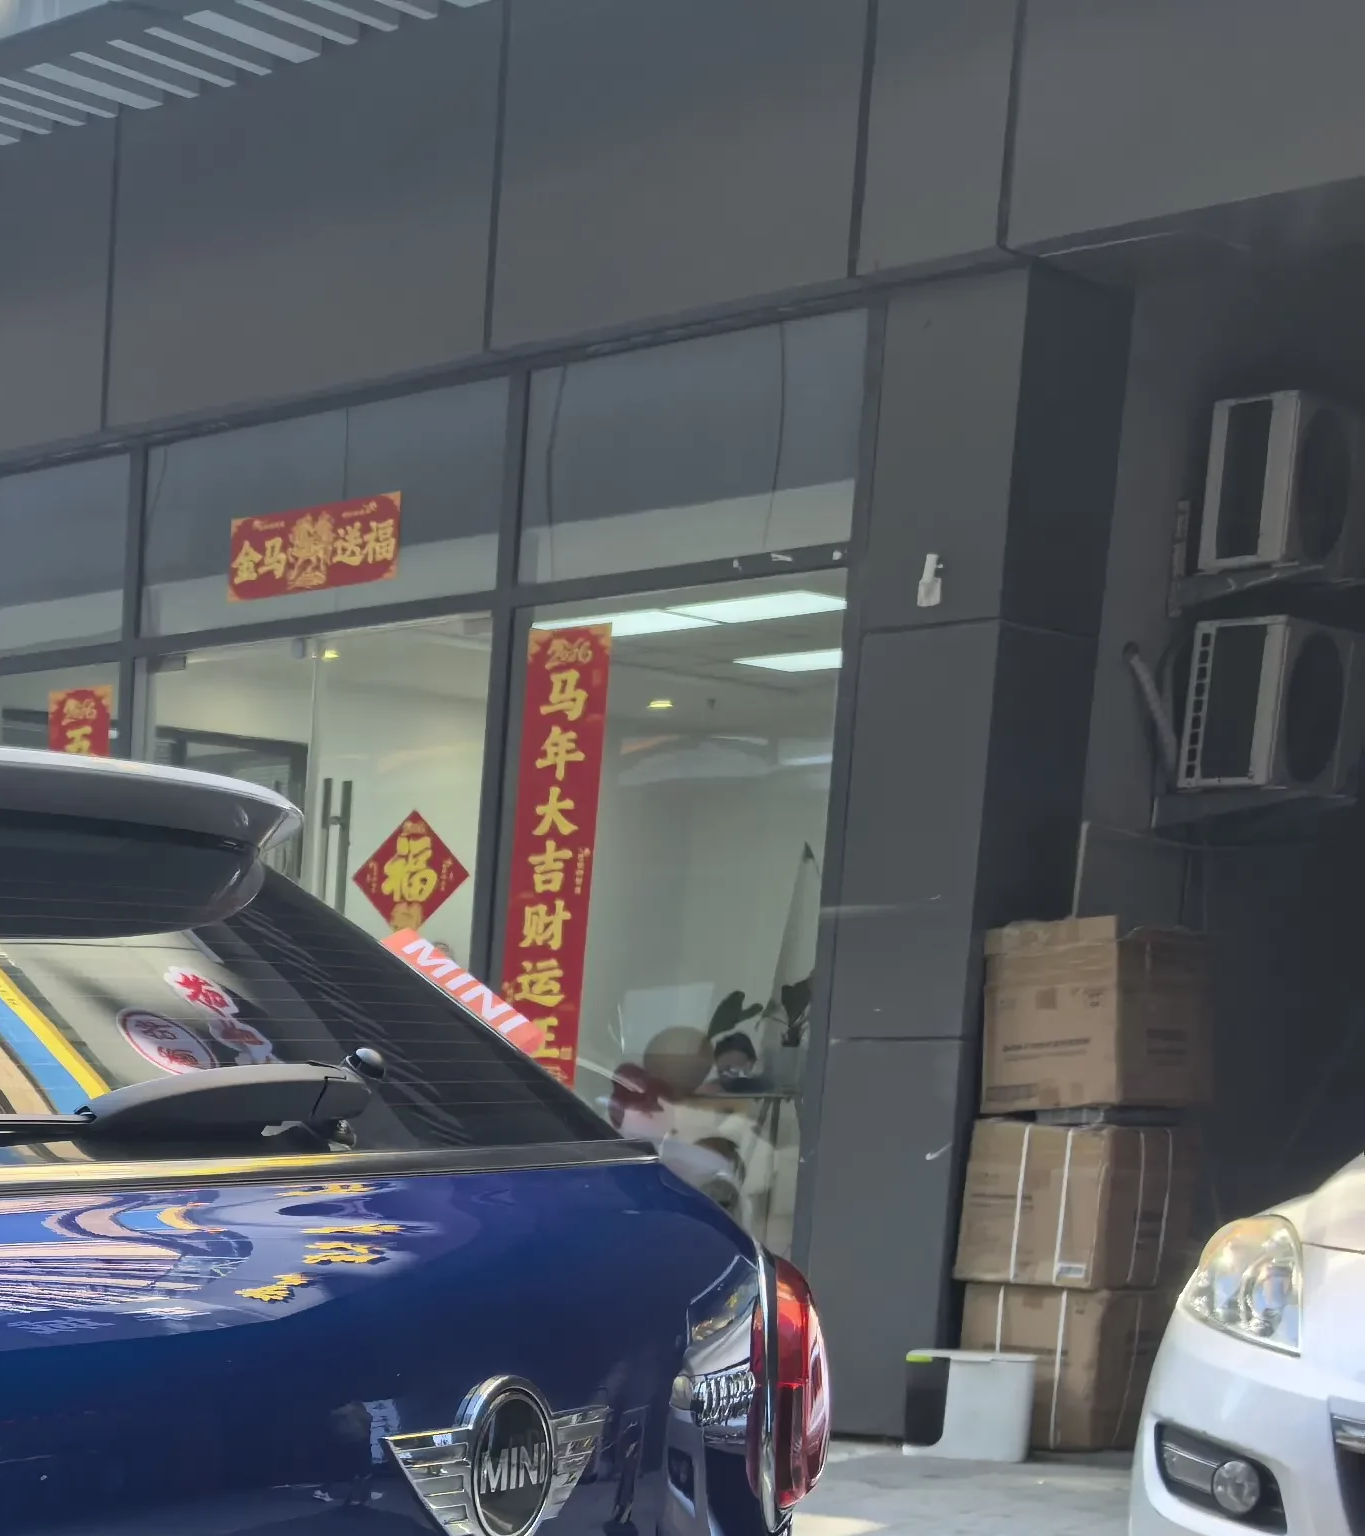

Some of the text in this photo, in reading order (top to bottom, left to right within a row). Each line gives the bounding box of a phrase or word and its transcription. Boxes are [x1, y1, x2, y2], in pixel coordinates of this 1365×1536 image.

[381, 836, 438, 902] 福
[402, 938, 529, 1034] MINI
[480, 1443, 546, 1493] MINI
